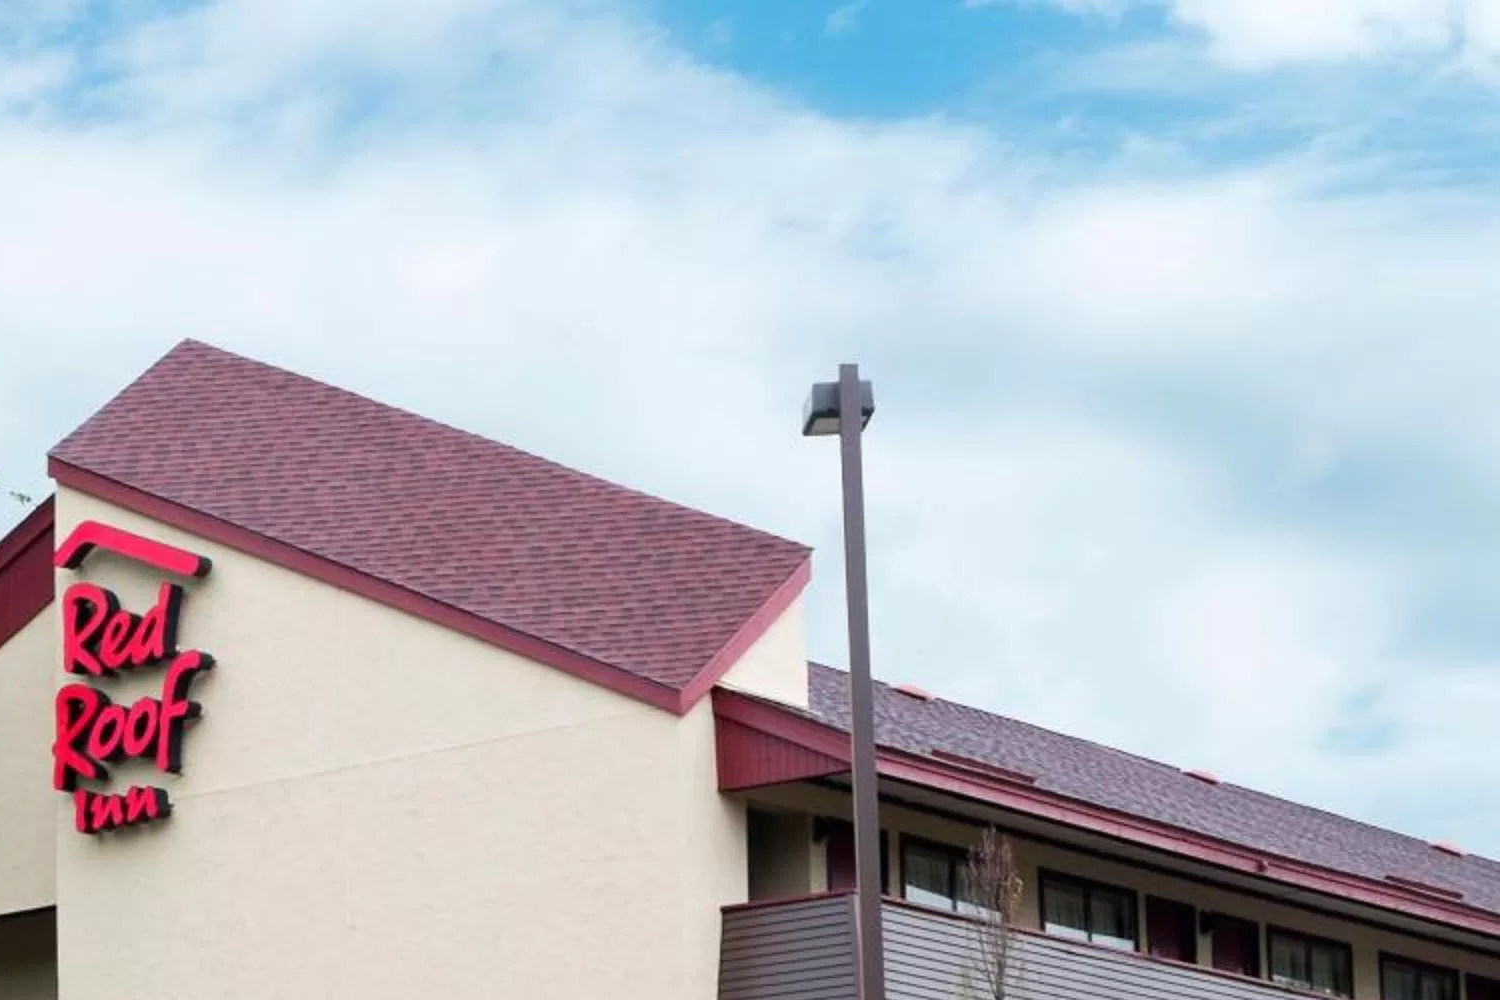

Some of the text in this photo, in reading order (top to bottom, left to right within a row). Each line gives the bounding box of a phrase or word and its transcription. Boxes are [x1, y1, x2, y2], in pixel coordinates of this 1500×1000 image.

[63, 581, 182, 676] Red
[52, 650, 212, 790] Roof
[74, 785, 168, 833] Inn
